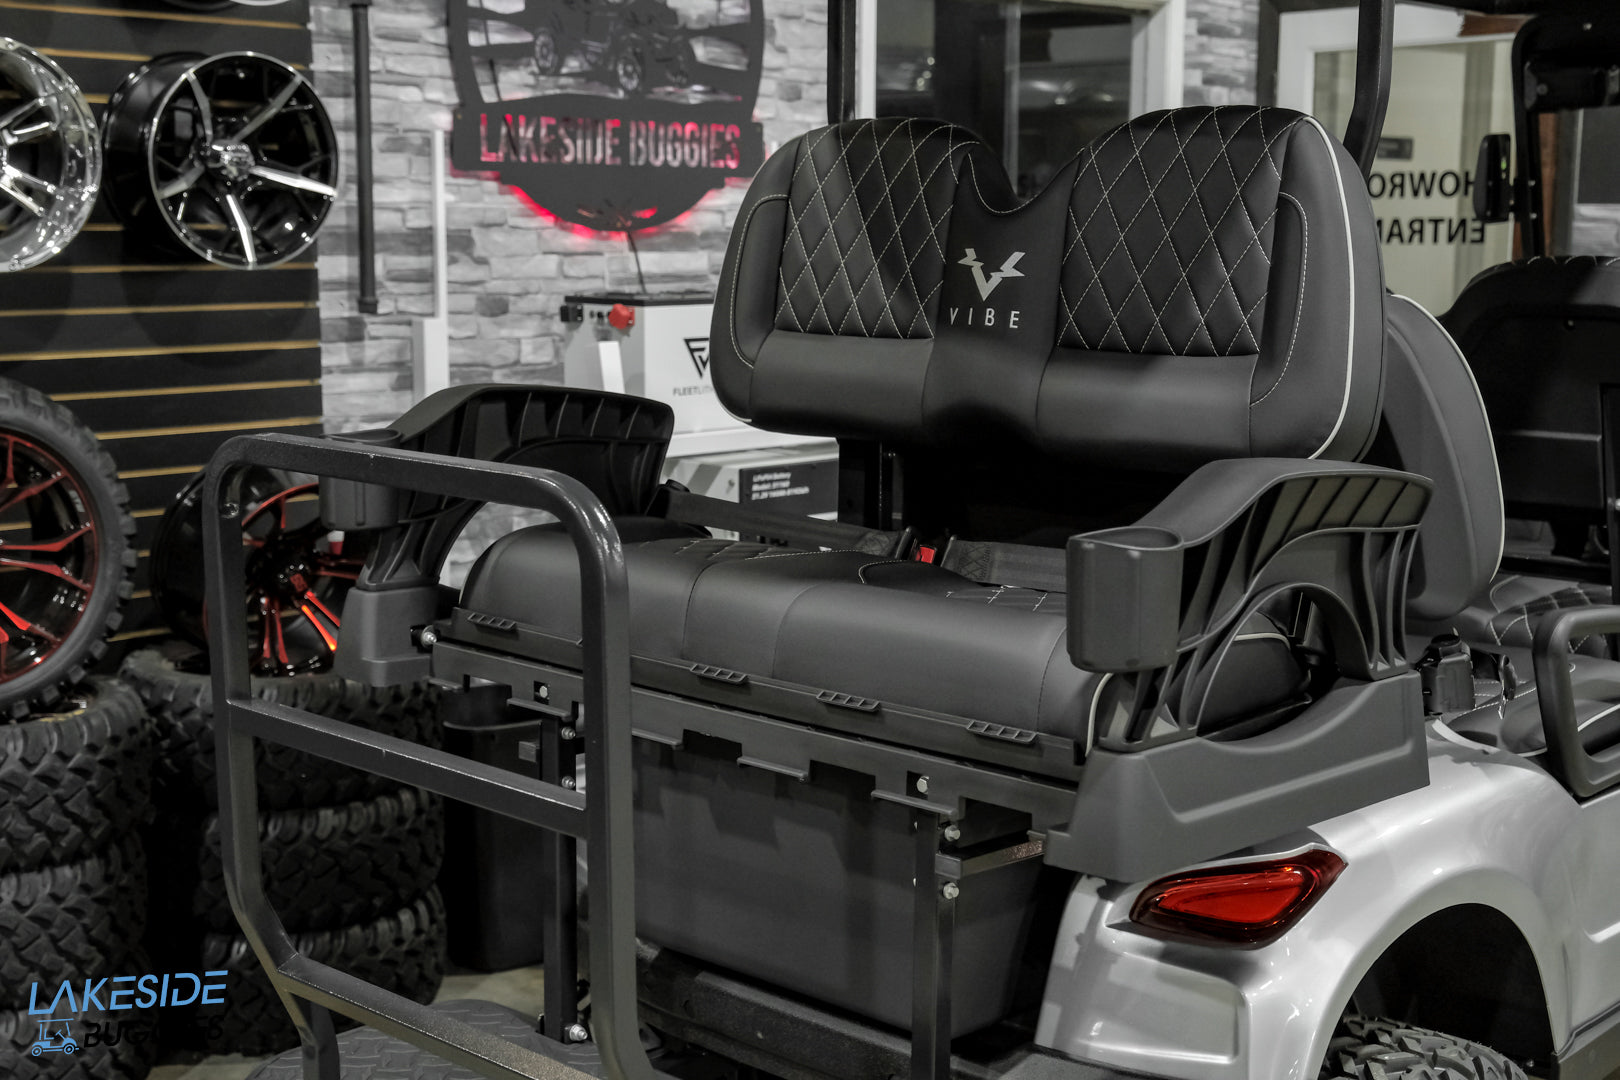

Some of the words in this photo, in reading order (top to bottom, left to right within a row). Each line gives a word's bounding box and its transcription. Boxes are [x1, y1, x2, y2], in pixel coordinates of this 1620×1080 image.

[480, 113, 622, 166] LAKESIDE
[629, 119, 741, 170] BUGGIES
[949, 306, 1021, 329] VIBE
